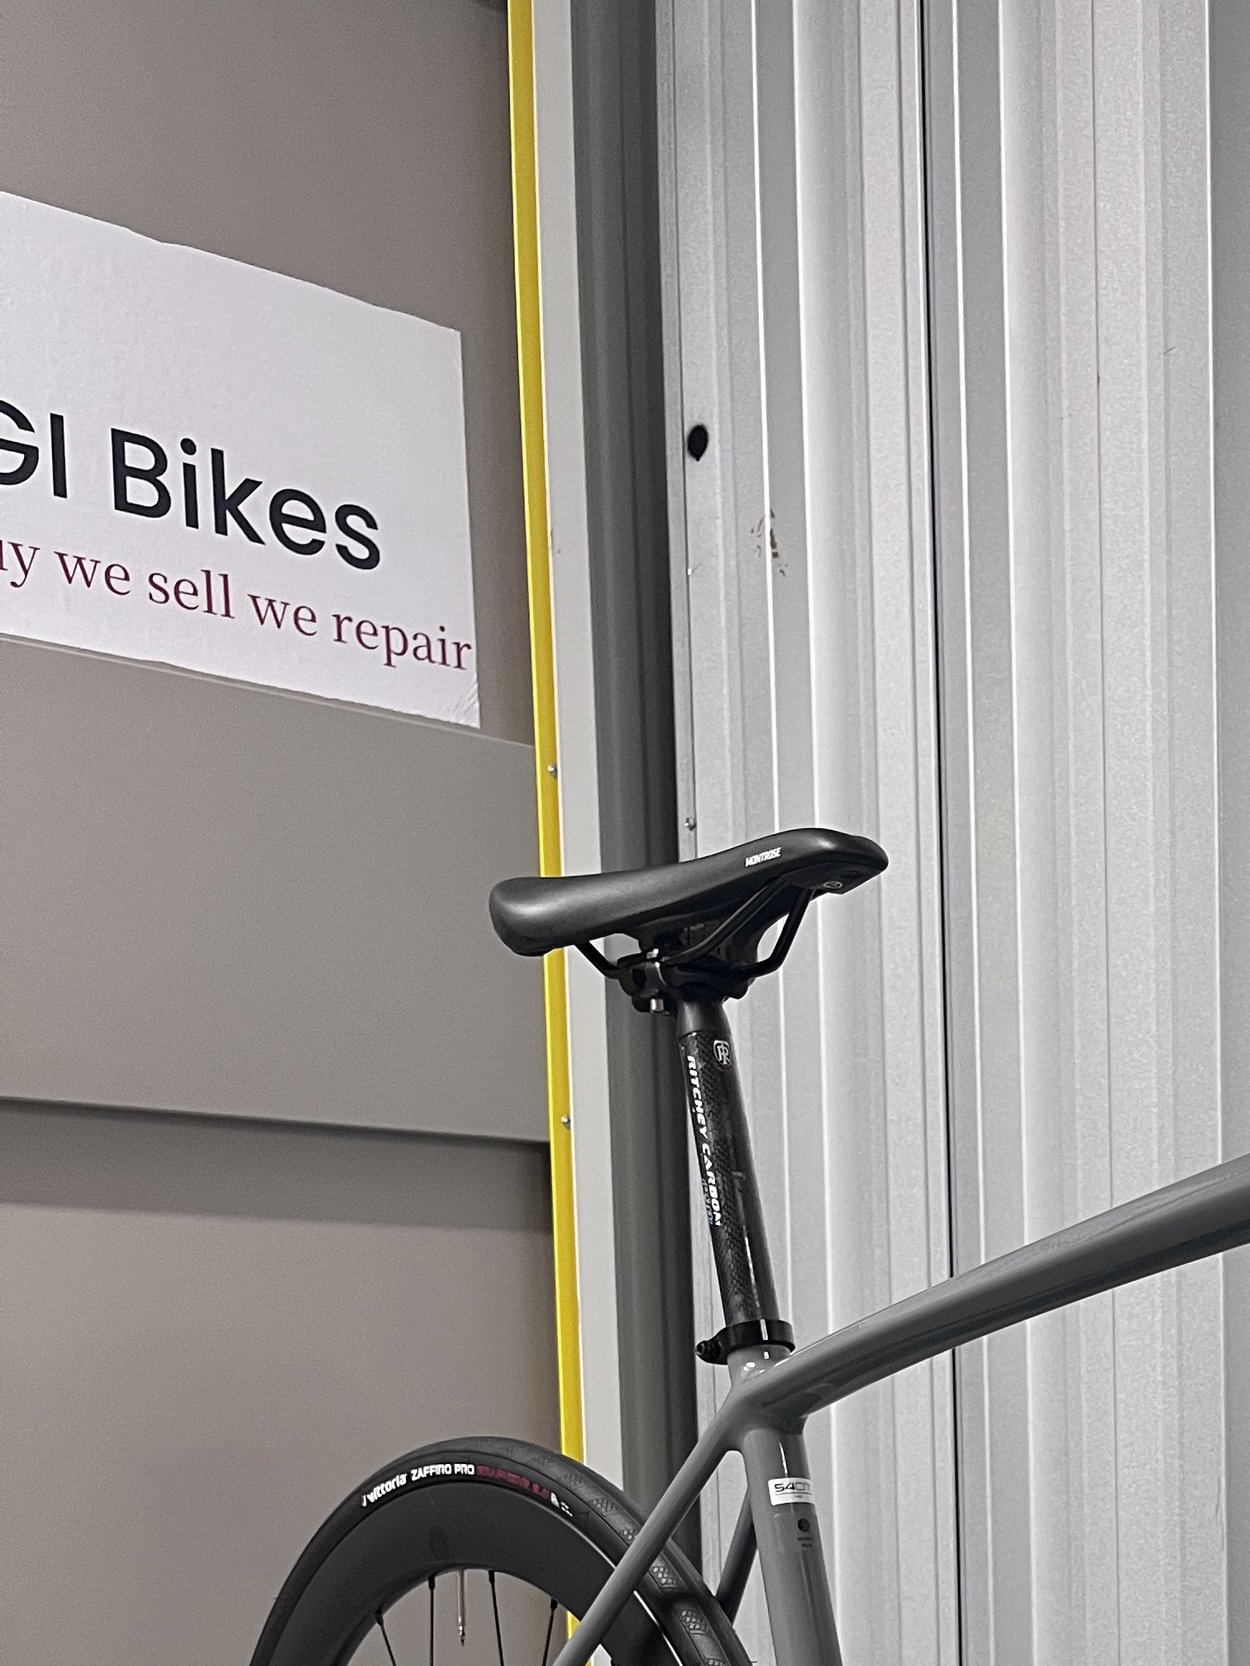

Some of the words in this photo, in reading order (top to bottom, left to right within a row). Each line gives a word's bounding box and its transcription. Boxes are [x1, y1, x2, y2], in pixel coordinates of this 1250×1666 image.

[111, 428, 380, 571] Bikes
[0, 540, 39, 588] y
[55, 551, 131, 596] we
[147, 569, 235, 619] sell
[247, 593, 318, 637] we
[332, 611, 472, 671] repair
[745, 846, 782, 868] MONTROSE
[686, 1055, 708, 1139] RITCHEY
[701, 1143, 722, 1227] CARBON
[453, 1463, 475, 1475] PRO
